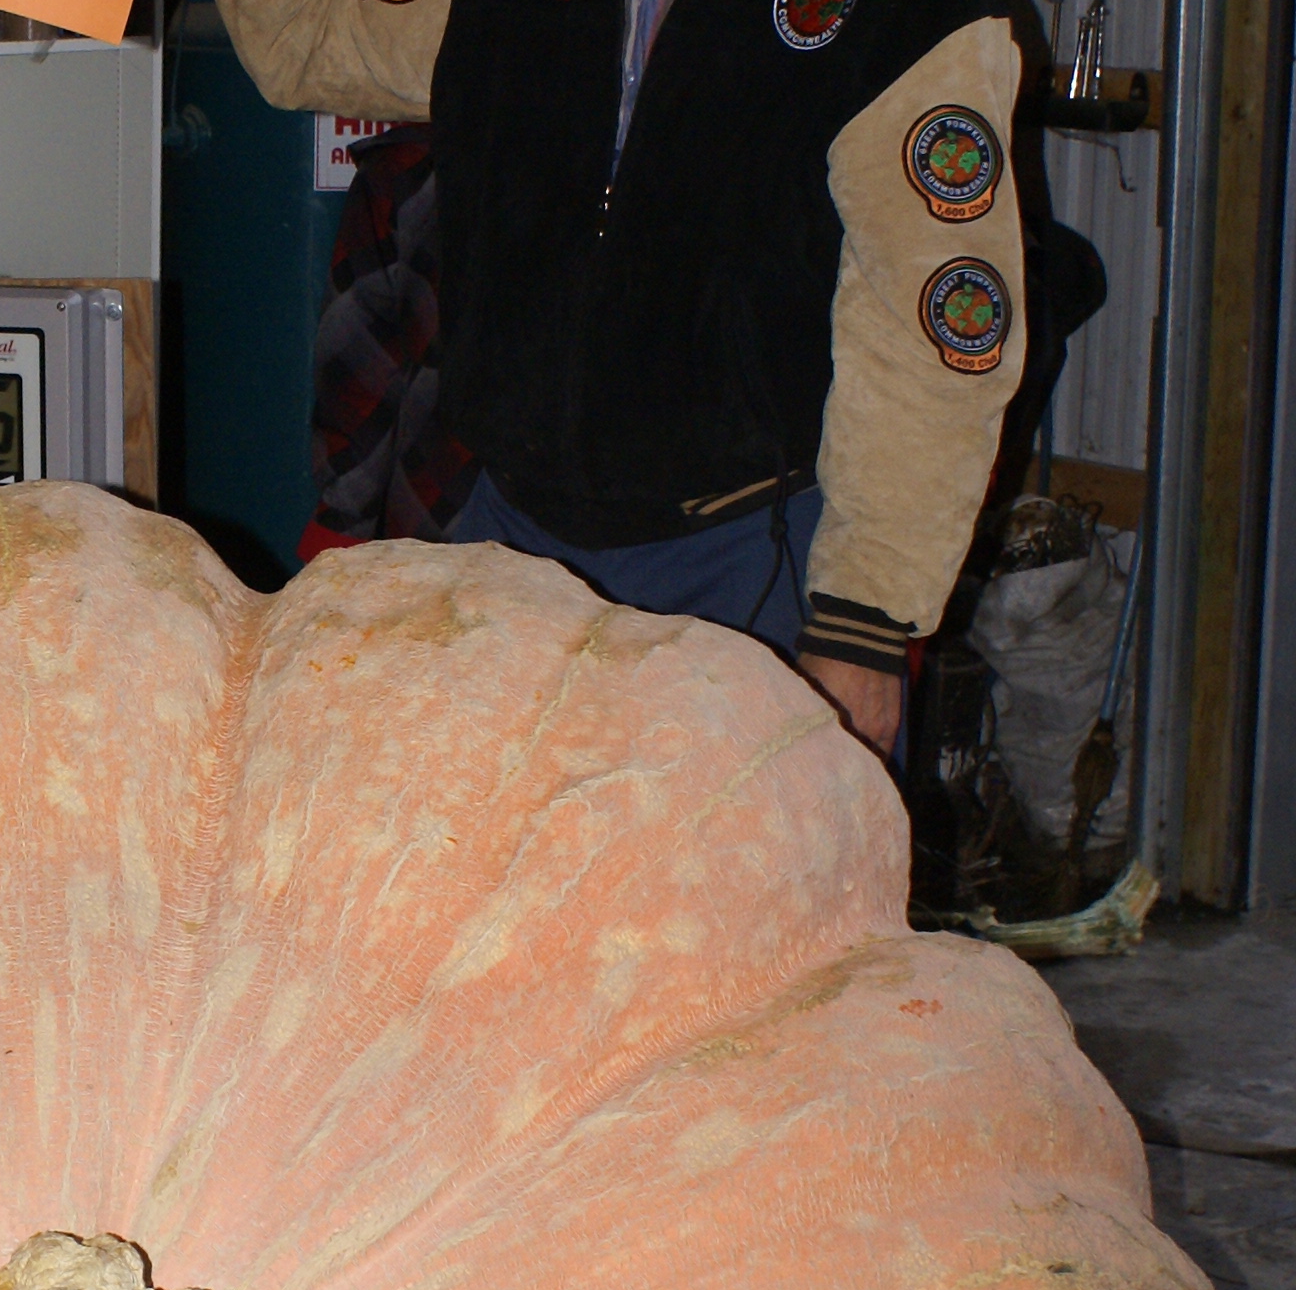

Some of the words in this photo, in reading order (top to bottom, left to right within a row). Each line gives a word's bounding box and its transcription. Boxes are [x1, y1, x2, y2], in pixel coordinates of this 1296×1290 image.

[777, 8, 844, 47] COMMONWEALTH
[917, 124, 941, 155] GREAT
[946, 119, 986, 147] PUMPKIN
